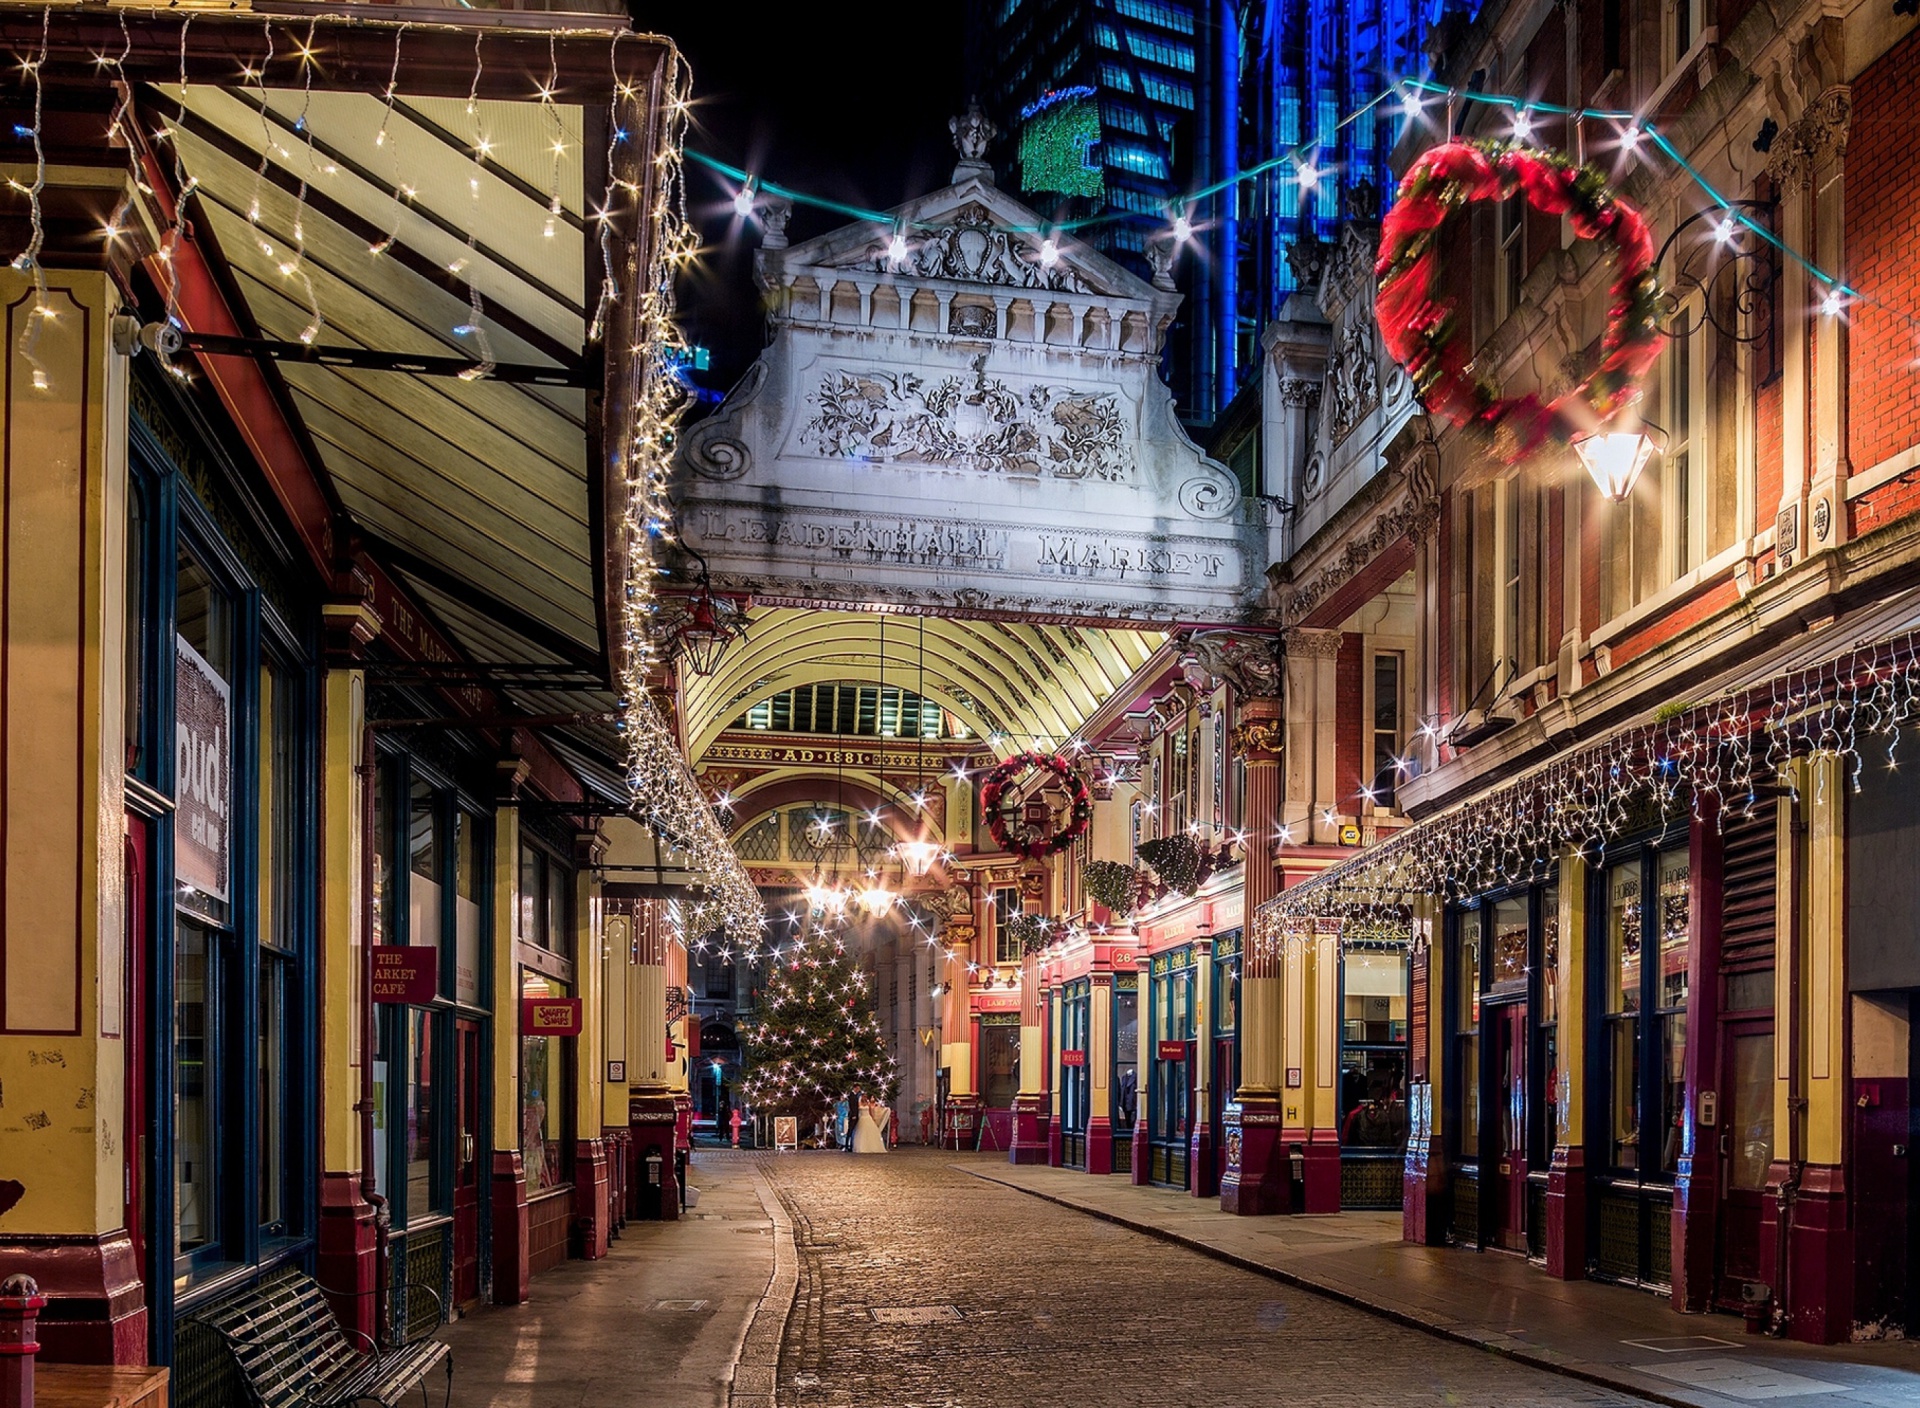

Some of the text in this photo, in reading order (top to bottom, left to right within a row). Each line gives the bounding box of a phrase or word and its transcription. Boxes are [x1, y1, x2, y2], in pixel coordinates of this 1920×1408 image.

[700, 509, 1225, 577] LEADENHALL MARKET
[391, 596, 413, 642] THE
[825, 751, 863, 764] 1881
[1665, 865, 1690, 887] HOBB
[377, 953, 403, 965] THE
[1116, 952, 1131, 963] 26
[375, 968, 416, 980] ARKET
[373, 981, 406, 995] CAFÉ
[1063, 1053, 1084, 1062] REISS
